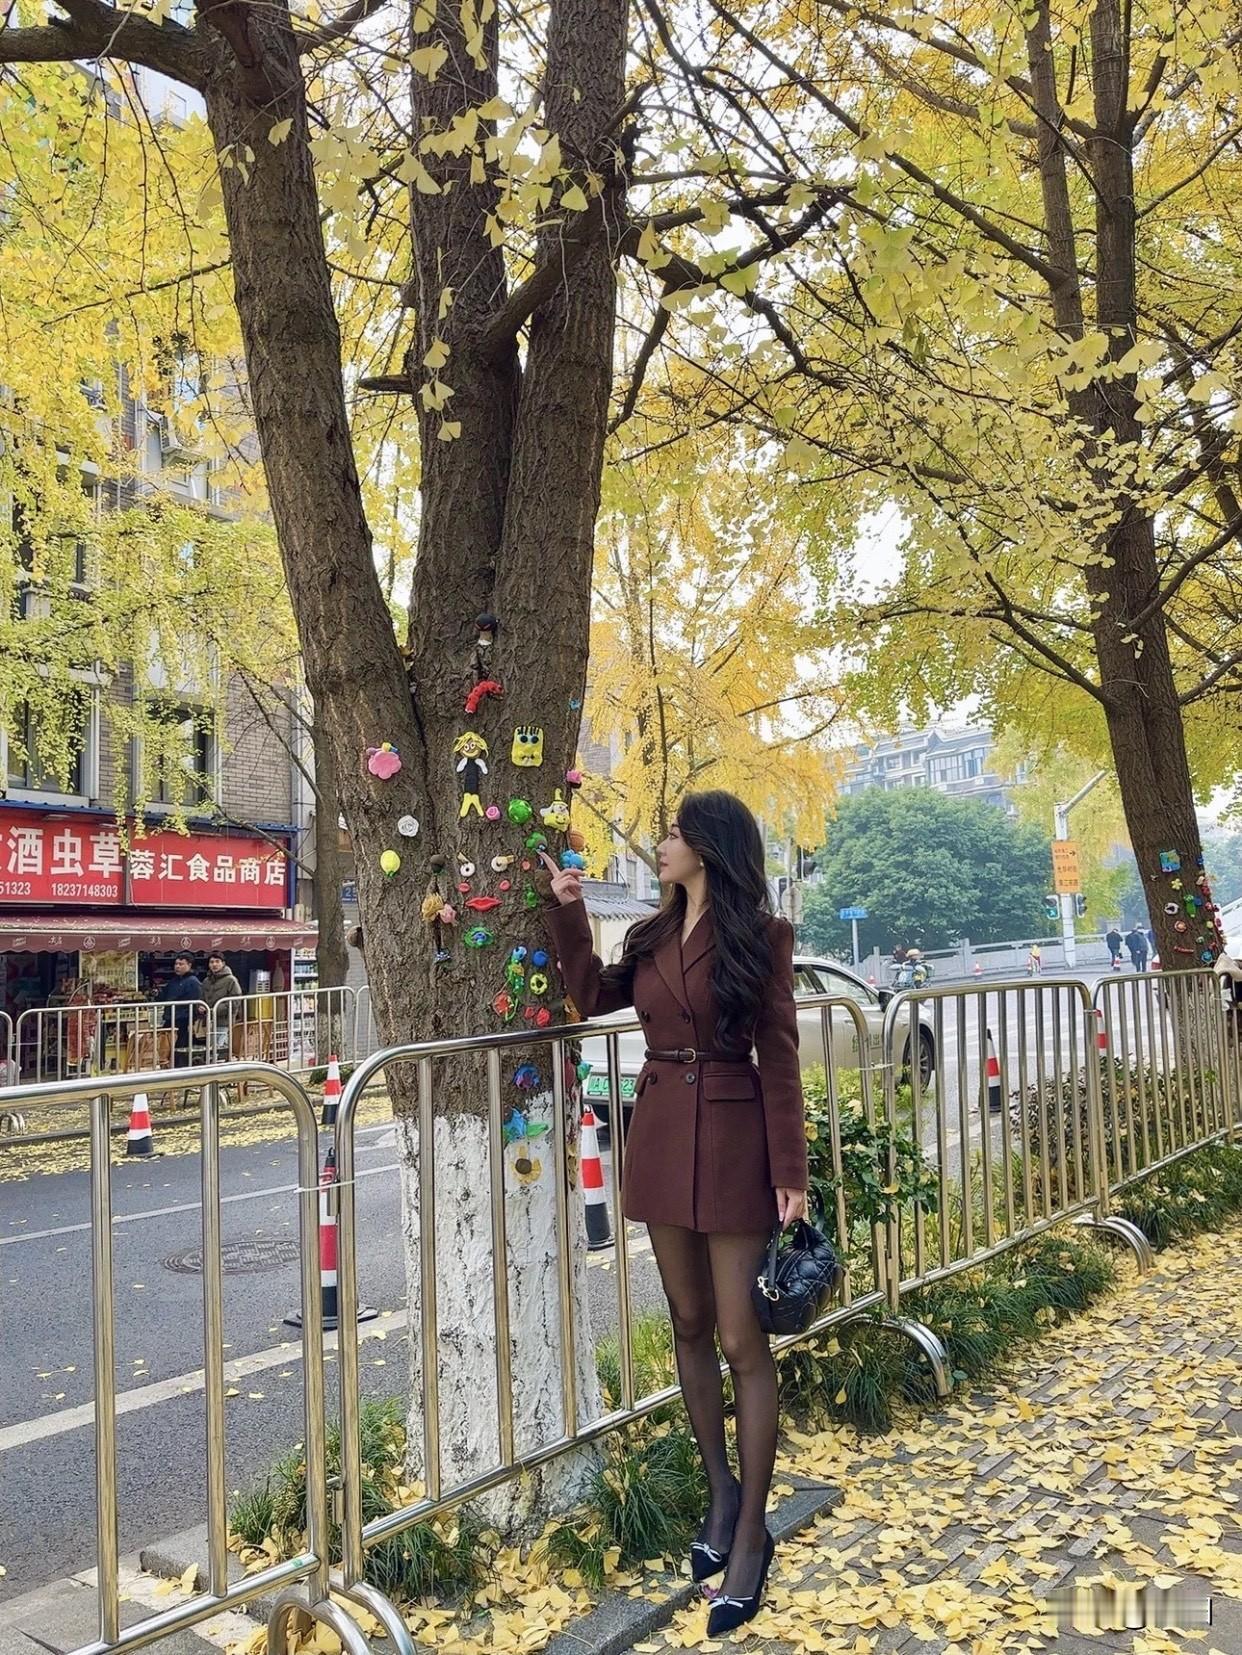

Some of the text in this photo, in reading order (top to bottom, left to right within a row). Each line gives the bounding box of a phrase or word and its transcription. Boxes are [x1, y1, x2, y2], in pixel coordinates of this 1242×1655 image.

[0, 826, 122, 878] 酒虫草
[129, 849, 286, 885] 蓉汇食品商店
[0, 881, 118, 898] 51323 18237148303
